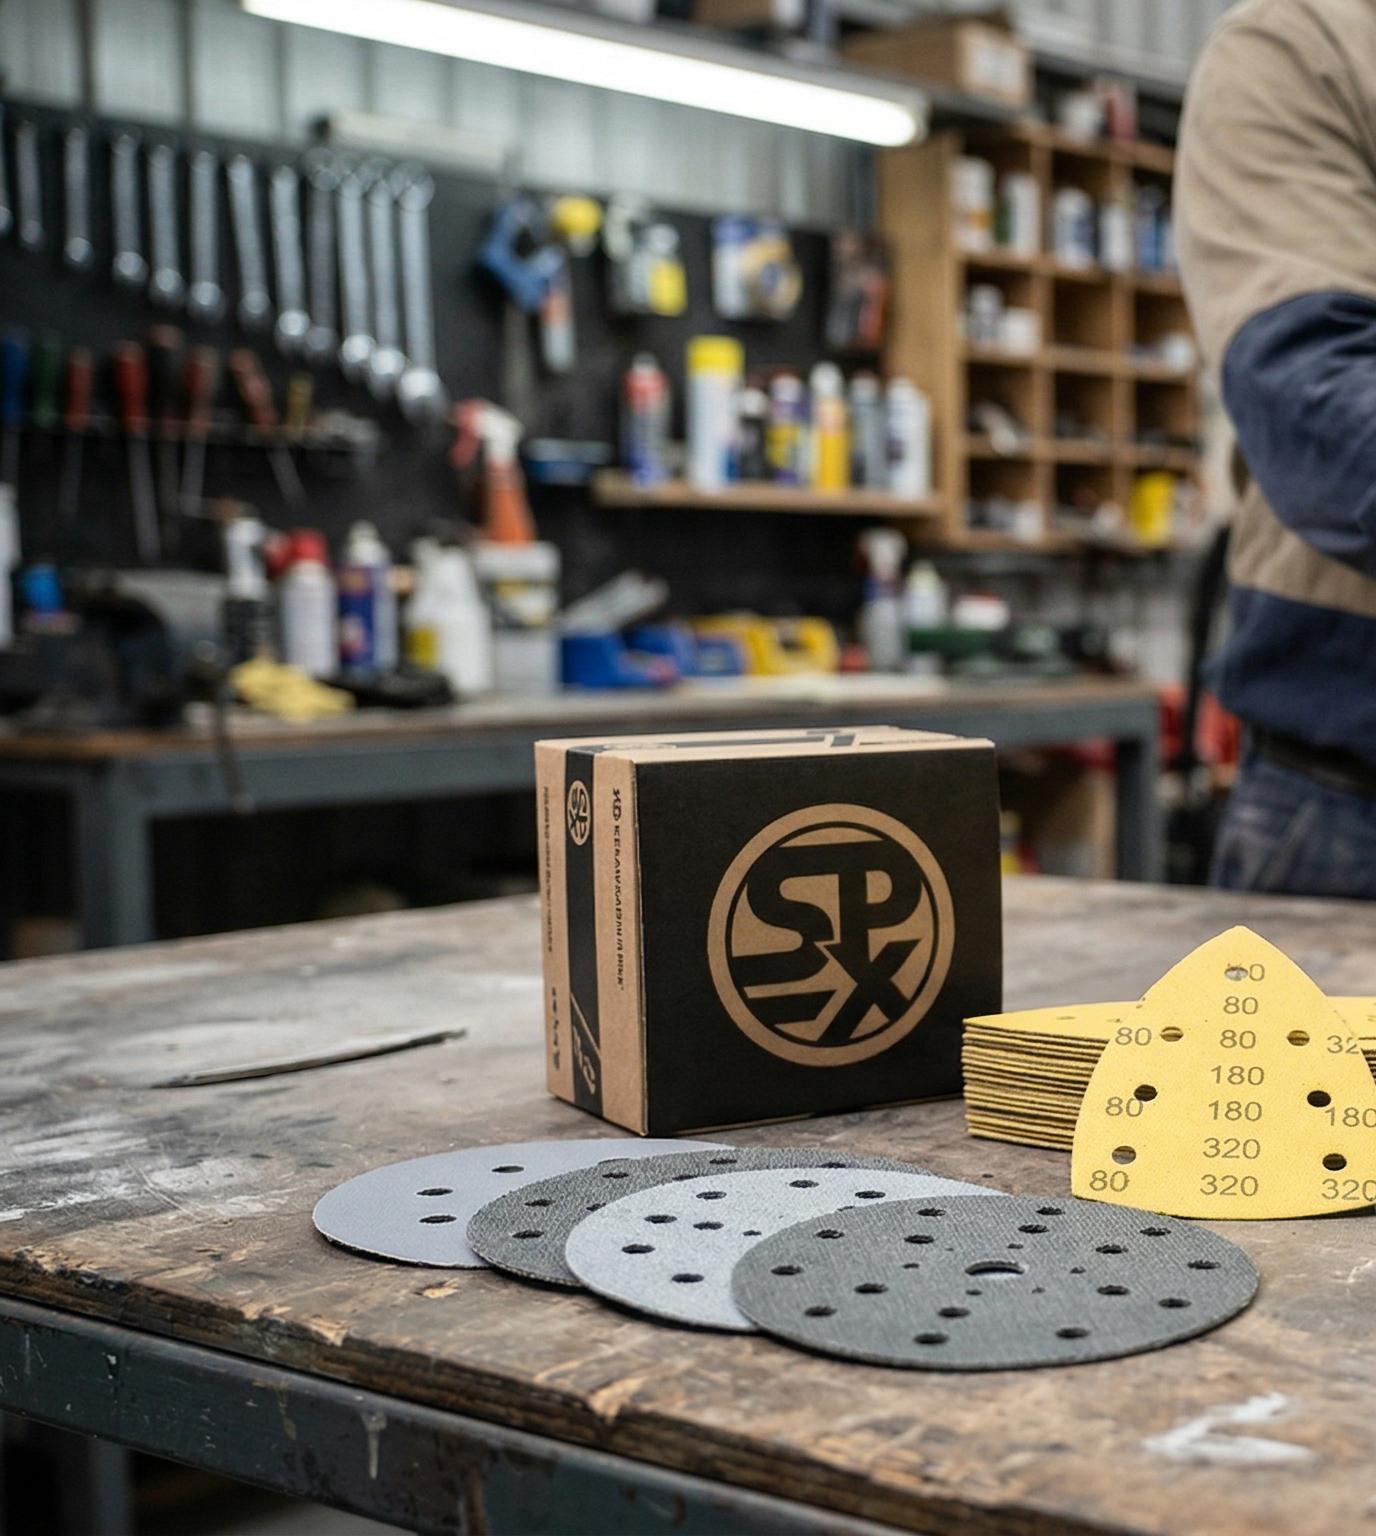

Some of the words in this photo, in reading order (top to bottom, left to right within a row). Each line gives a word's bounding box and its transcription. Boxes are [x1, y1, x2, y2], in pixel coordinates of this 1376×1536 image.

[729, 835, 926, 1043] SPX
[1223, 996, 1259, 1015] 80
[1115, 1027, 1152, 1046] 80
[1219, 1029, 1257, 1049] 80
[1211, 1065, 1265, 1086] 180
[1105, 1096, 1144, 1117] 80
[1208, 1100, 1262, 1121] 180
[1202, 1137, 1261, 1160] 320
[1089, 1170, 1130, 1192] 80
[1200, 1174, 1259, 1197] 320
